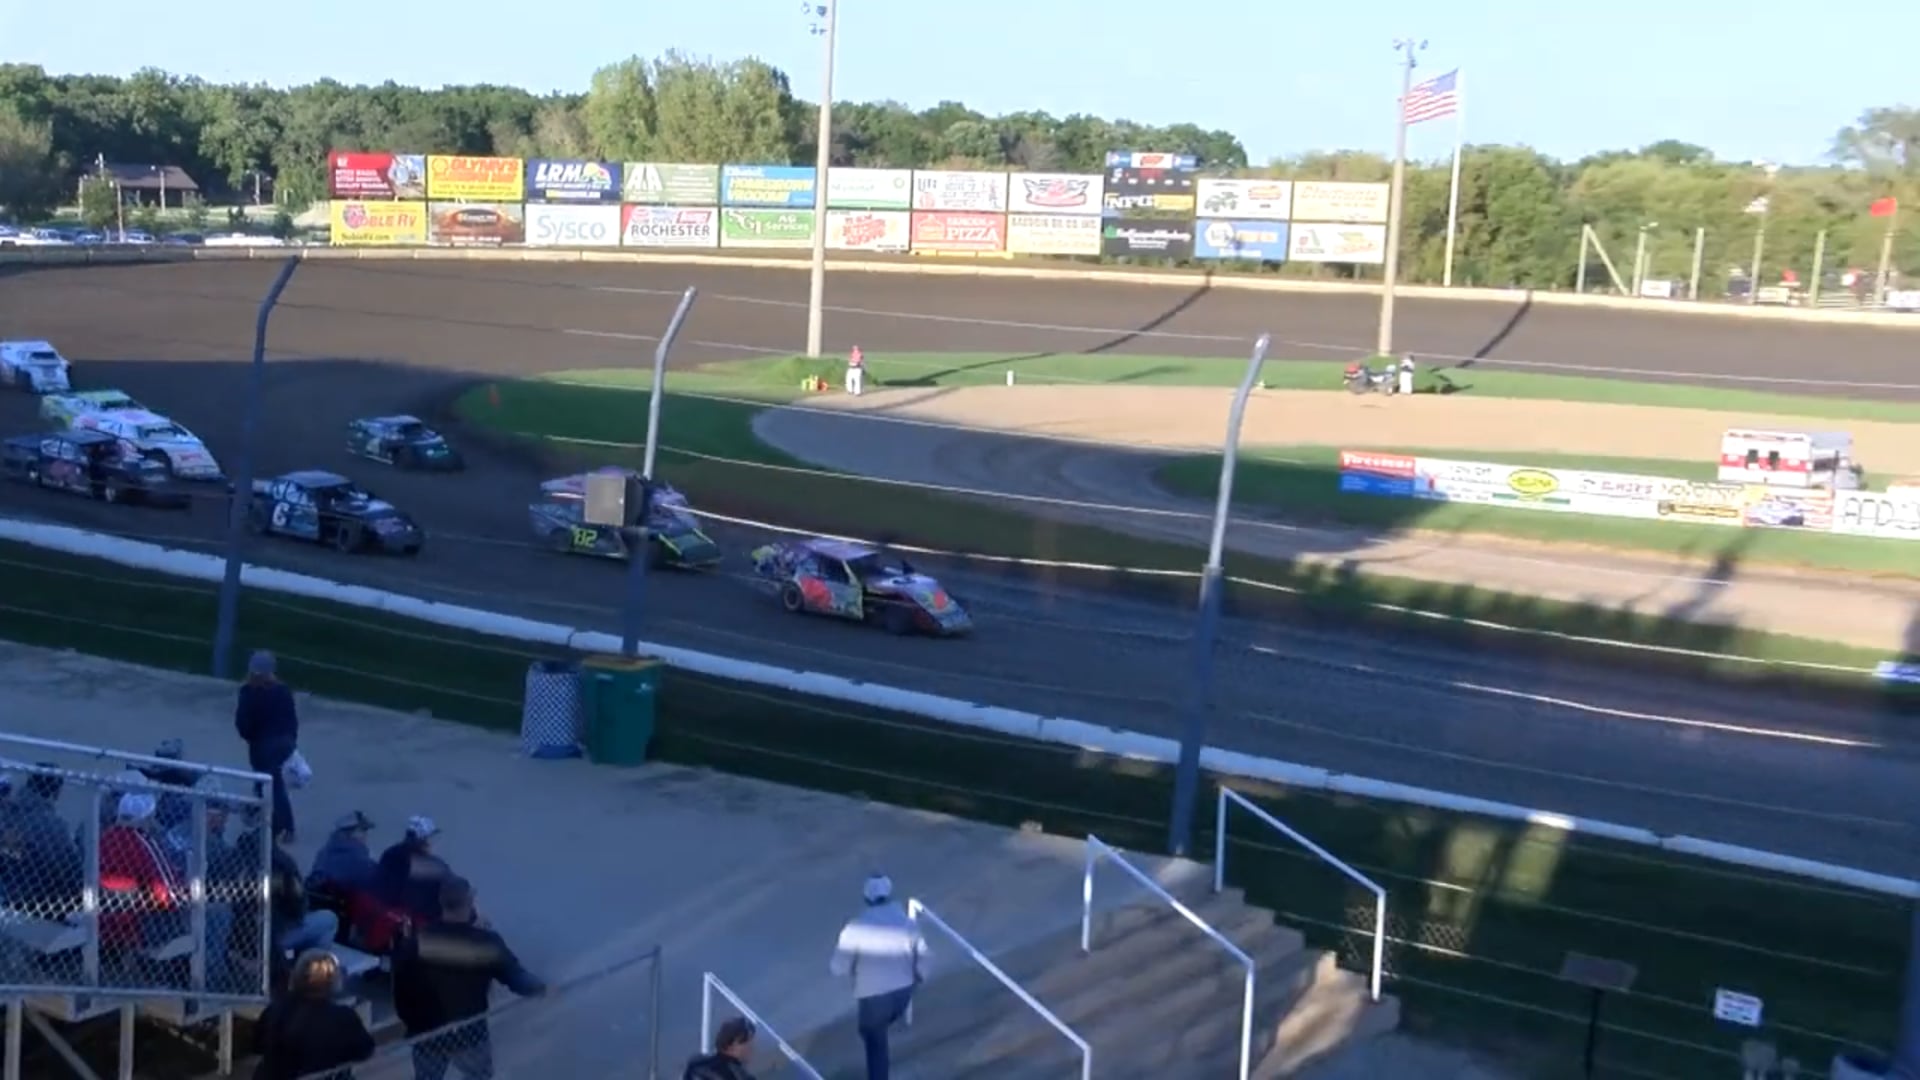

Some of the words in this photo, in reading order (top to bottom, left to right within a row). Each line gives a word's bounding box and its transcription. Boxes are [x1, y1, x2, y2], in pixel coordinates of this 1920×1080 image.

[535, 163, 582, 182] LRM
[536, 214, 606, 244] Sysco
[631, 224, 711, 237] ROCHESTER
[946, 226, 1001, 242] PIZZA
[1342, 452, 1413, 469] Firestone
[272, 502, 290, 526] 6
